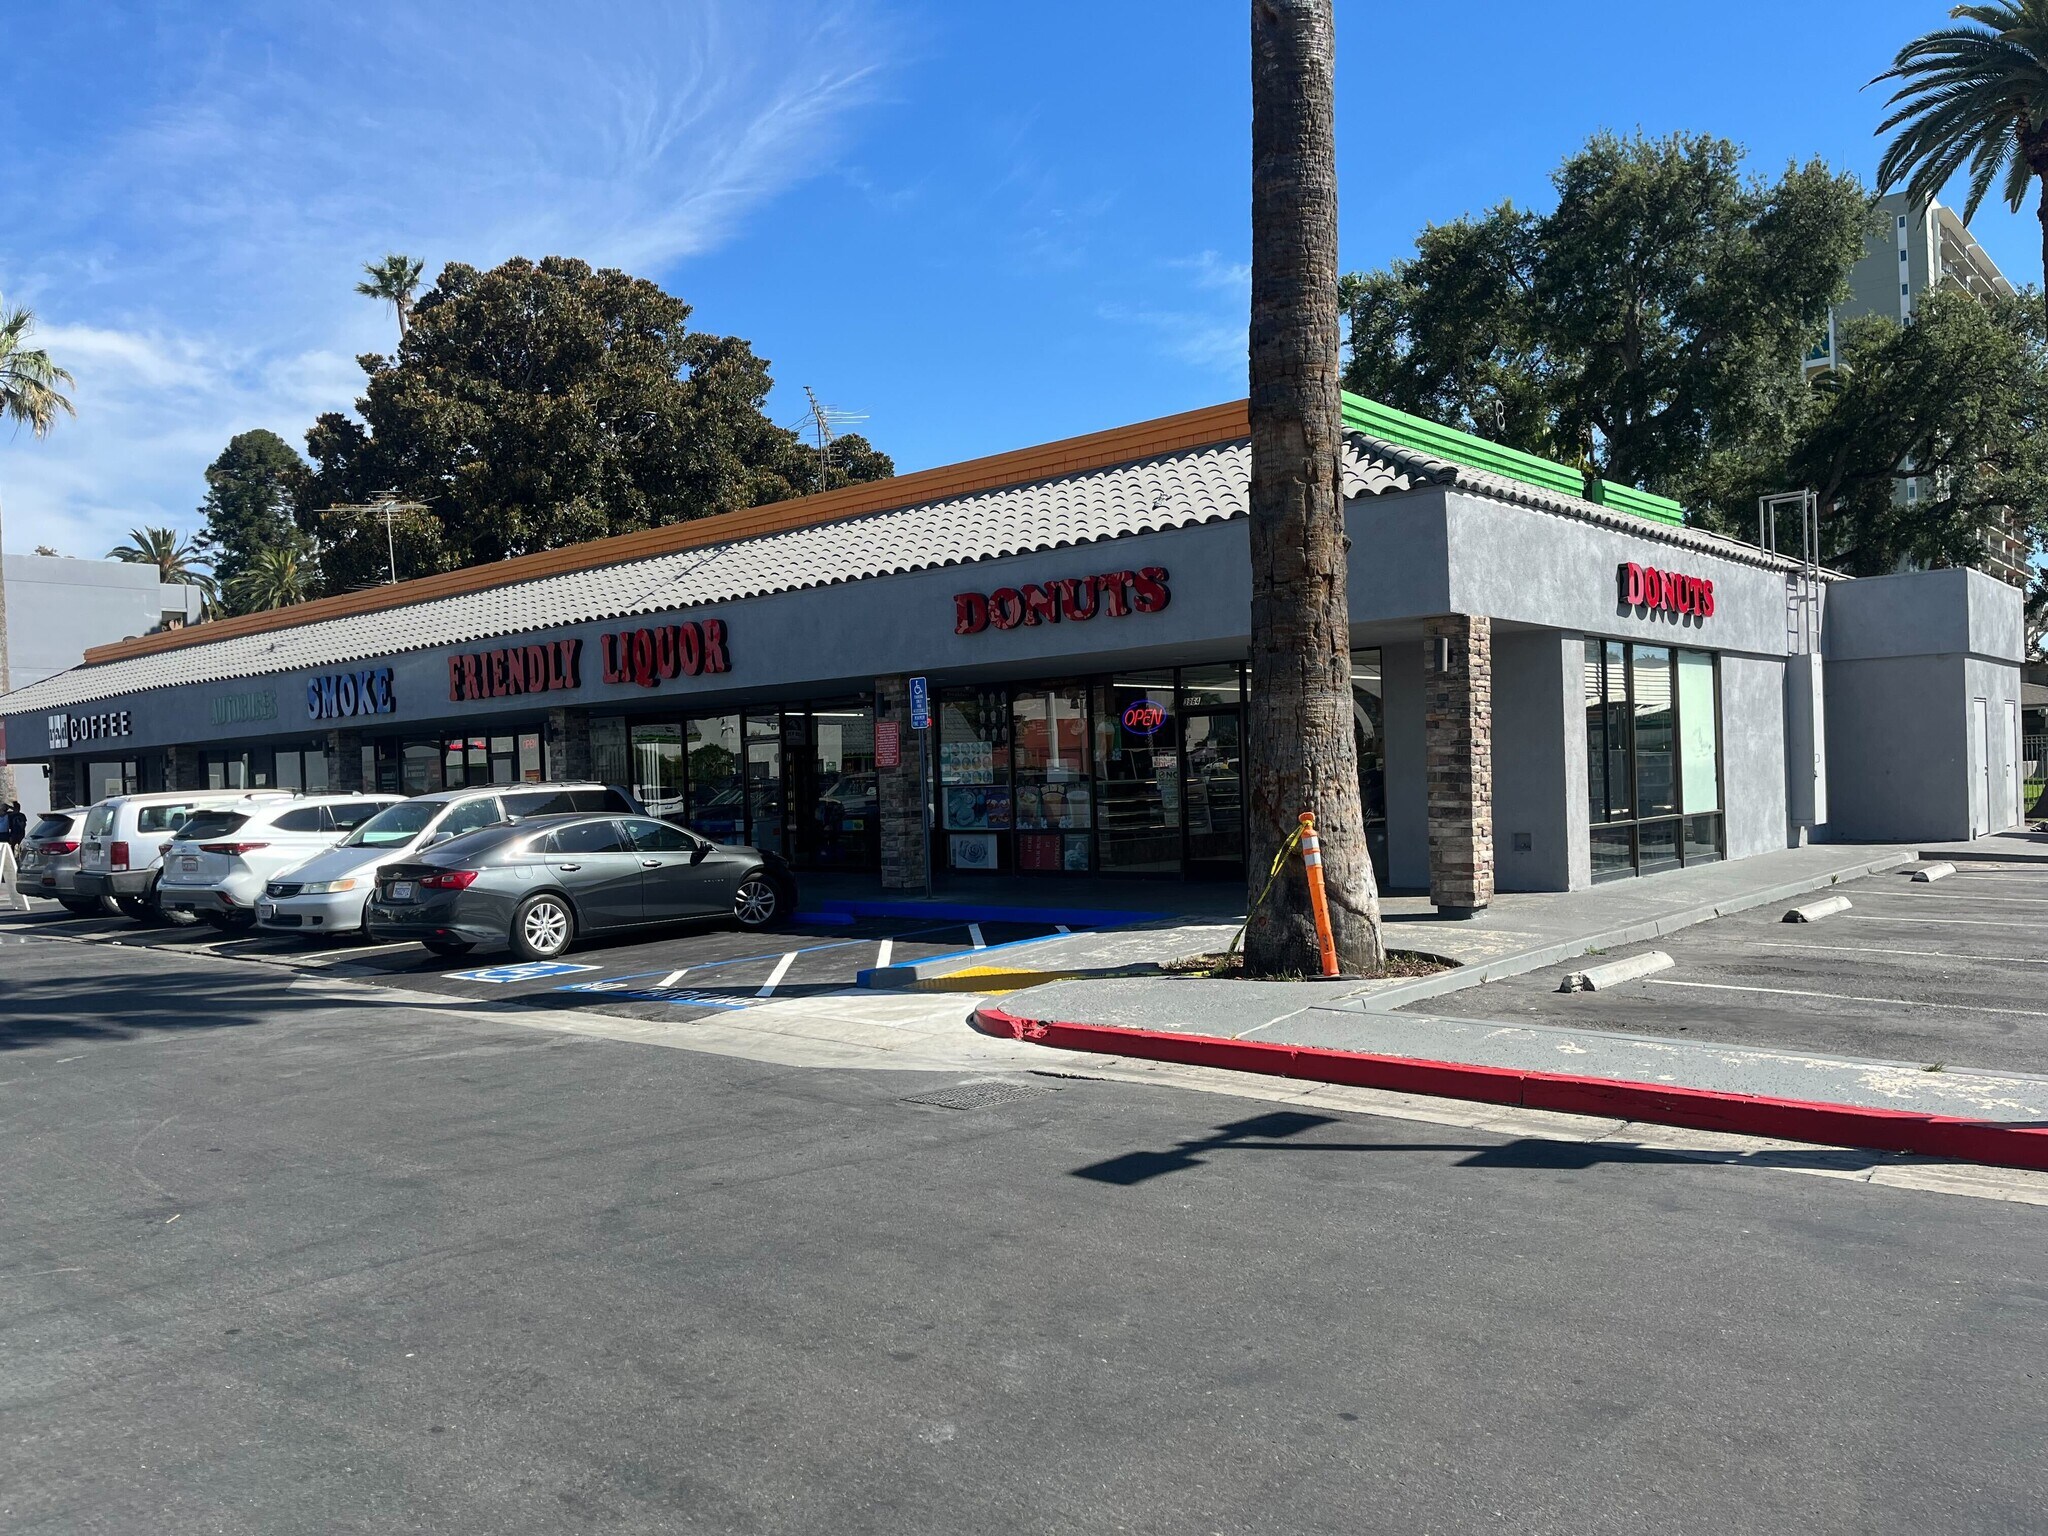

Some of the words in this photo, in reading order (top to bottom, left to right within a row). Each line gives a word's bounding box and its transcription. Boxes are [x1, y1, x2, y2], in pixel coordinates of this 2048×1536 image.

[954, 567, 1169, 635] DONUTS
[1627, 561, 1715, 617] DONUTS
[448, 640, 582, 701] FRIENDLY
[601, 619, 730, 688] LIQUOR
[307, 668, 394, 720] SMOKE
[70, 711, 130, 741] COFFEE
[1124, 708, 1164, 727] OPEN
[570, 981, 628, 991] NO
[627, 987, 767, 1006] PARKING
